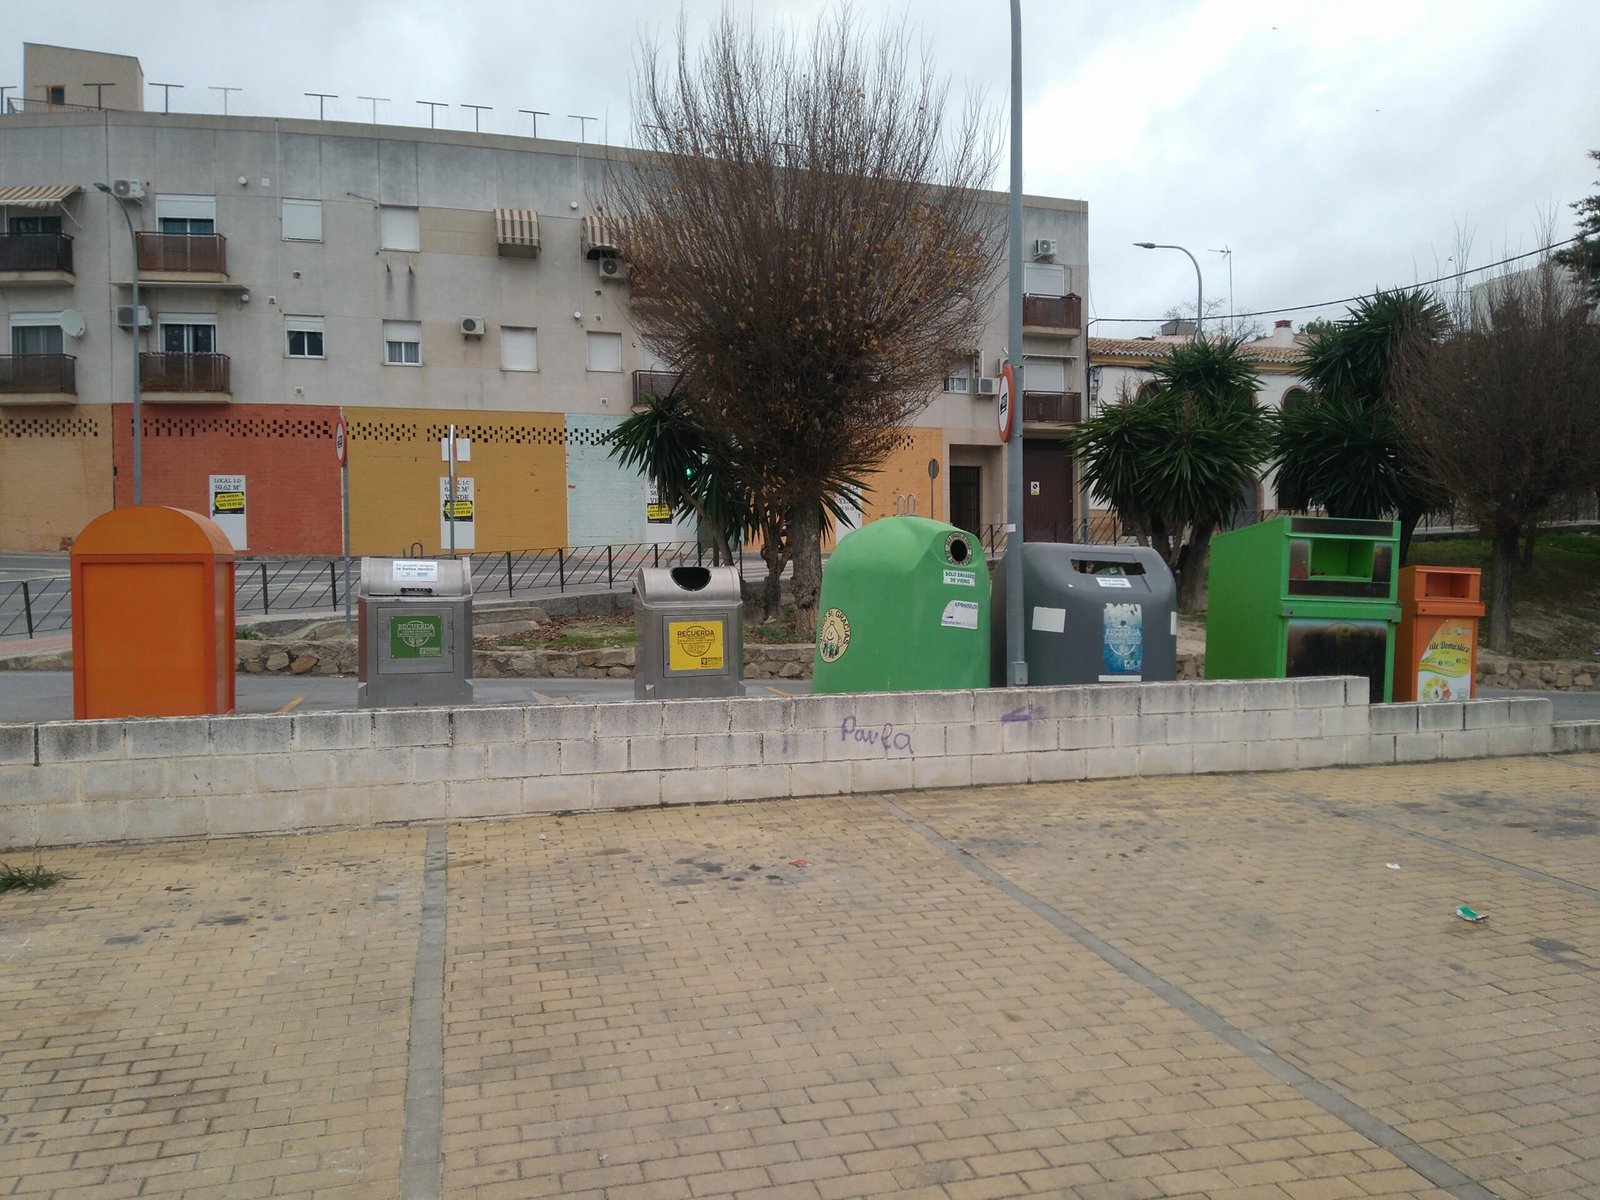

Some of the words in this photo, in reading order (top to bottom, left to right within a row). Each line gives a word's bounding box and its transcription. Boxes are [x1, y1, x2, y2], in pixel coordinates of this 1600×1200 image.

[397, 623, 435, 631] RECUERDA
[677, 630, 714, 638] RECUERDA
[835, 610, 850, 645] GRACIAS
[841, 715, 915, 755] Paula
